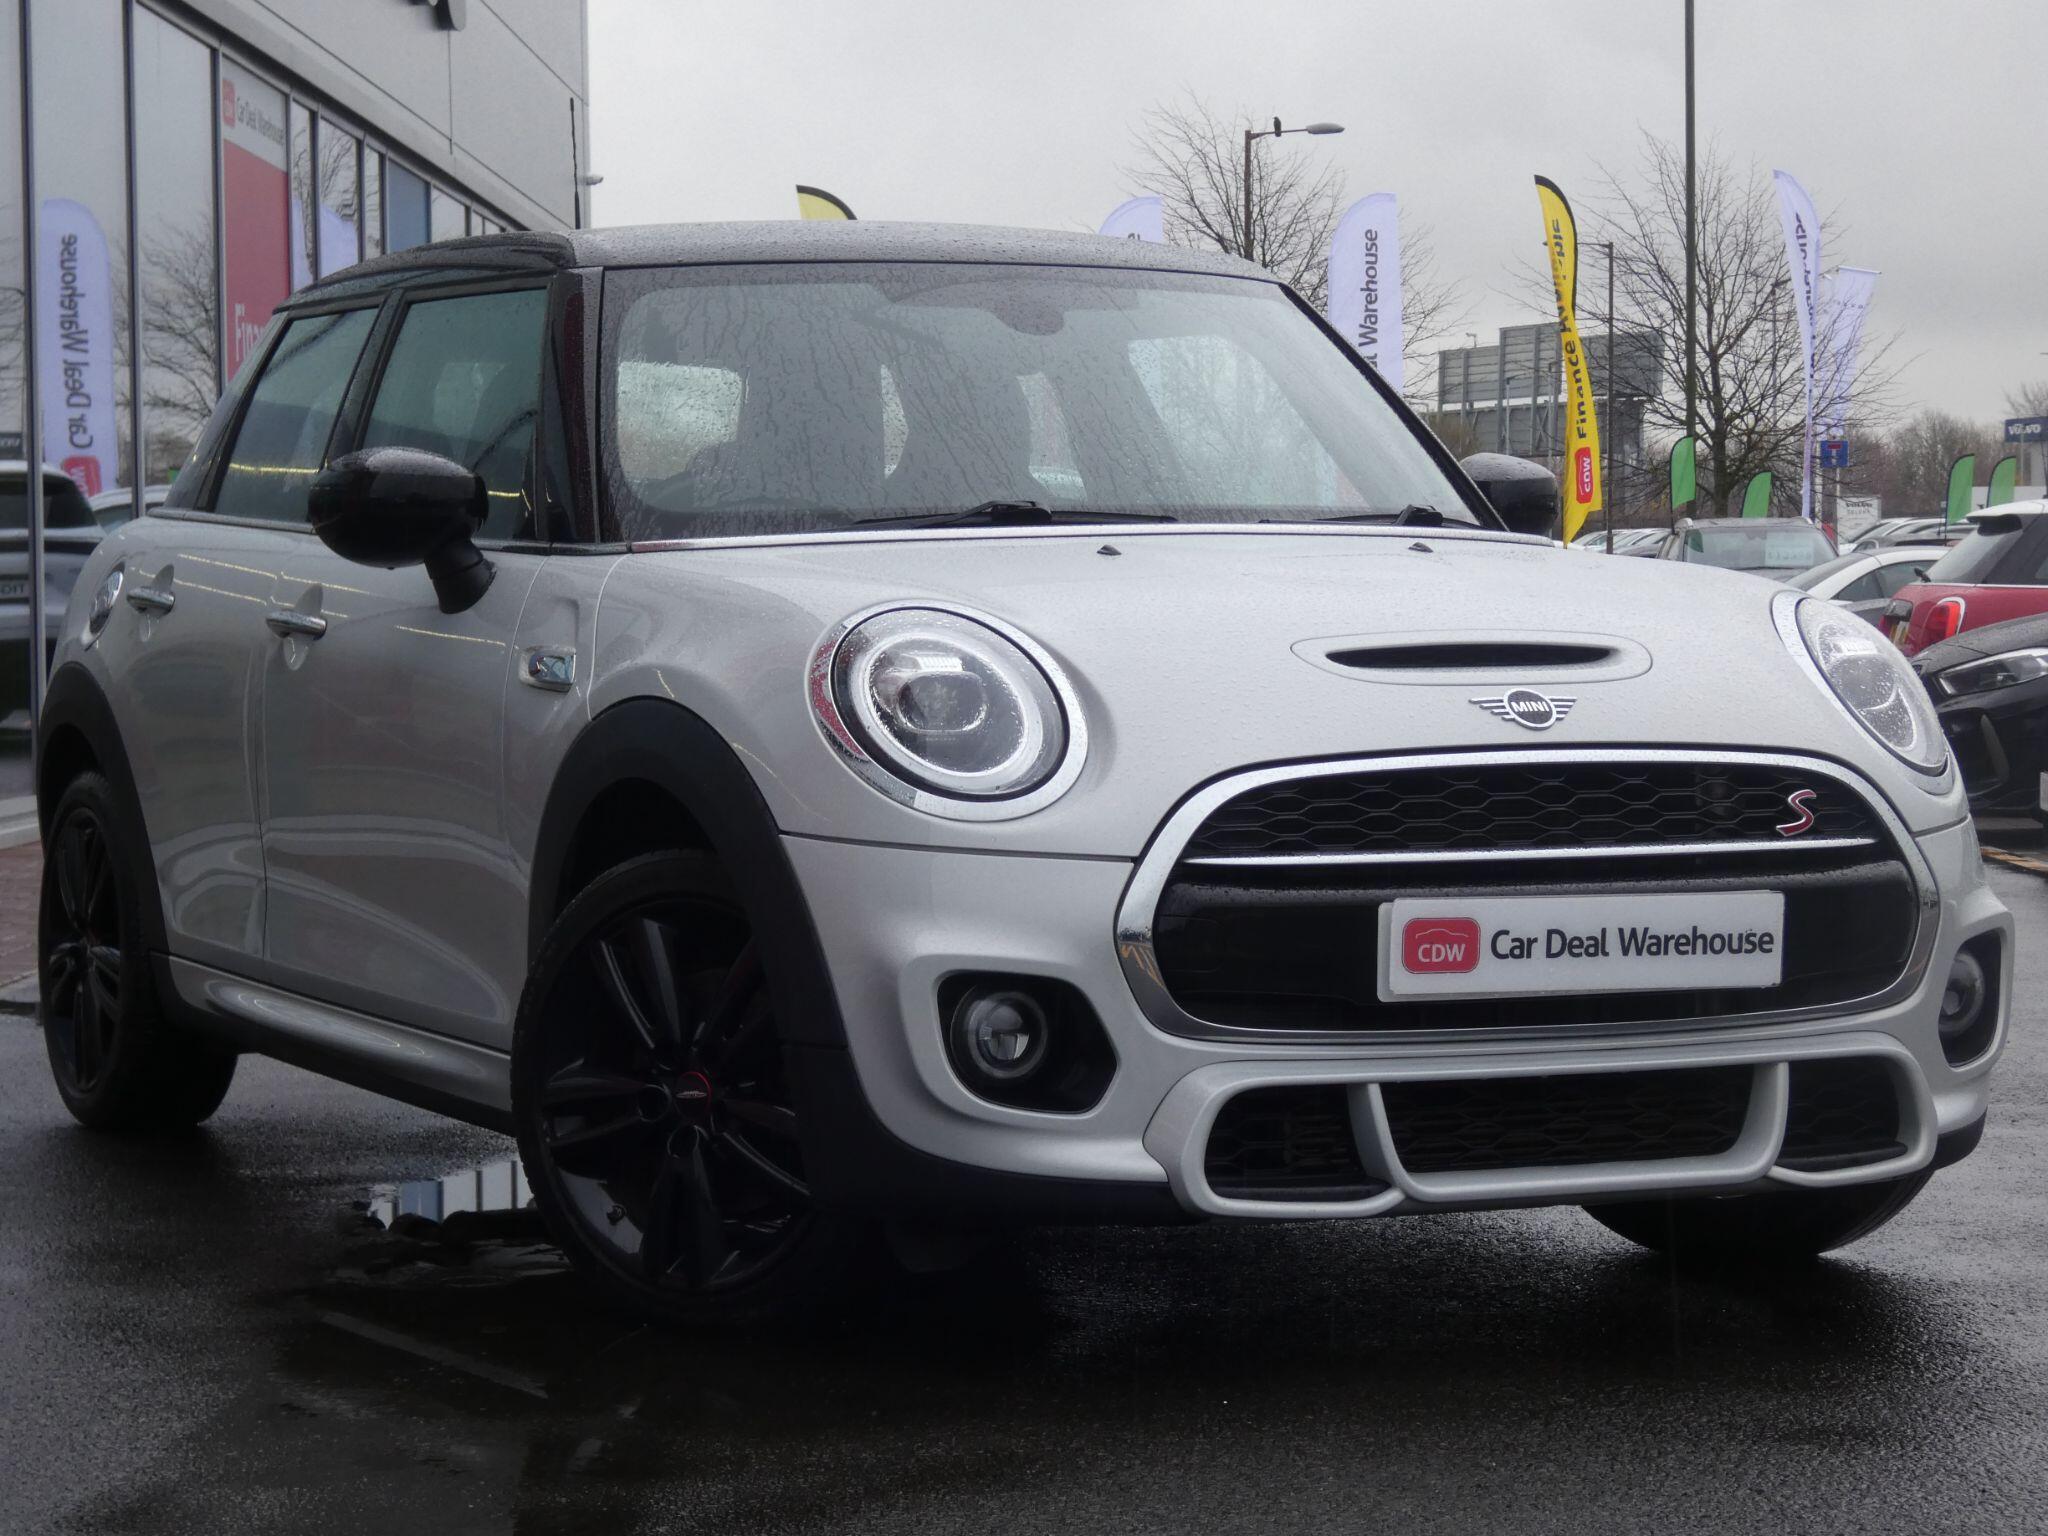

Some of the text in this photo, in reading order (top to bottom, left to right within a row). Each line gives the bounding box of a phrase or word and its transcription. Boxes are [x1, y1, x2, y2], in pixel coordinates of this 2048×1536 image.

[1358, 229, 1378, 347] Warehouse
[1565, 340, 1587, 439] Finance
[1583, 457, 1592, 493] CDW
[1510, 701, 1551, 712] MINI
[1776, 789, 1817, 837] S
[1418, 943, 1466, 963] CDW
[1490, 925, 1775, 960] Car Deal Warehouse
